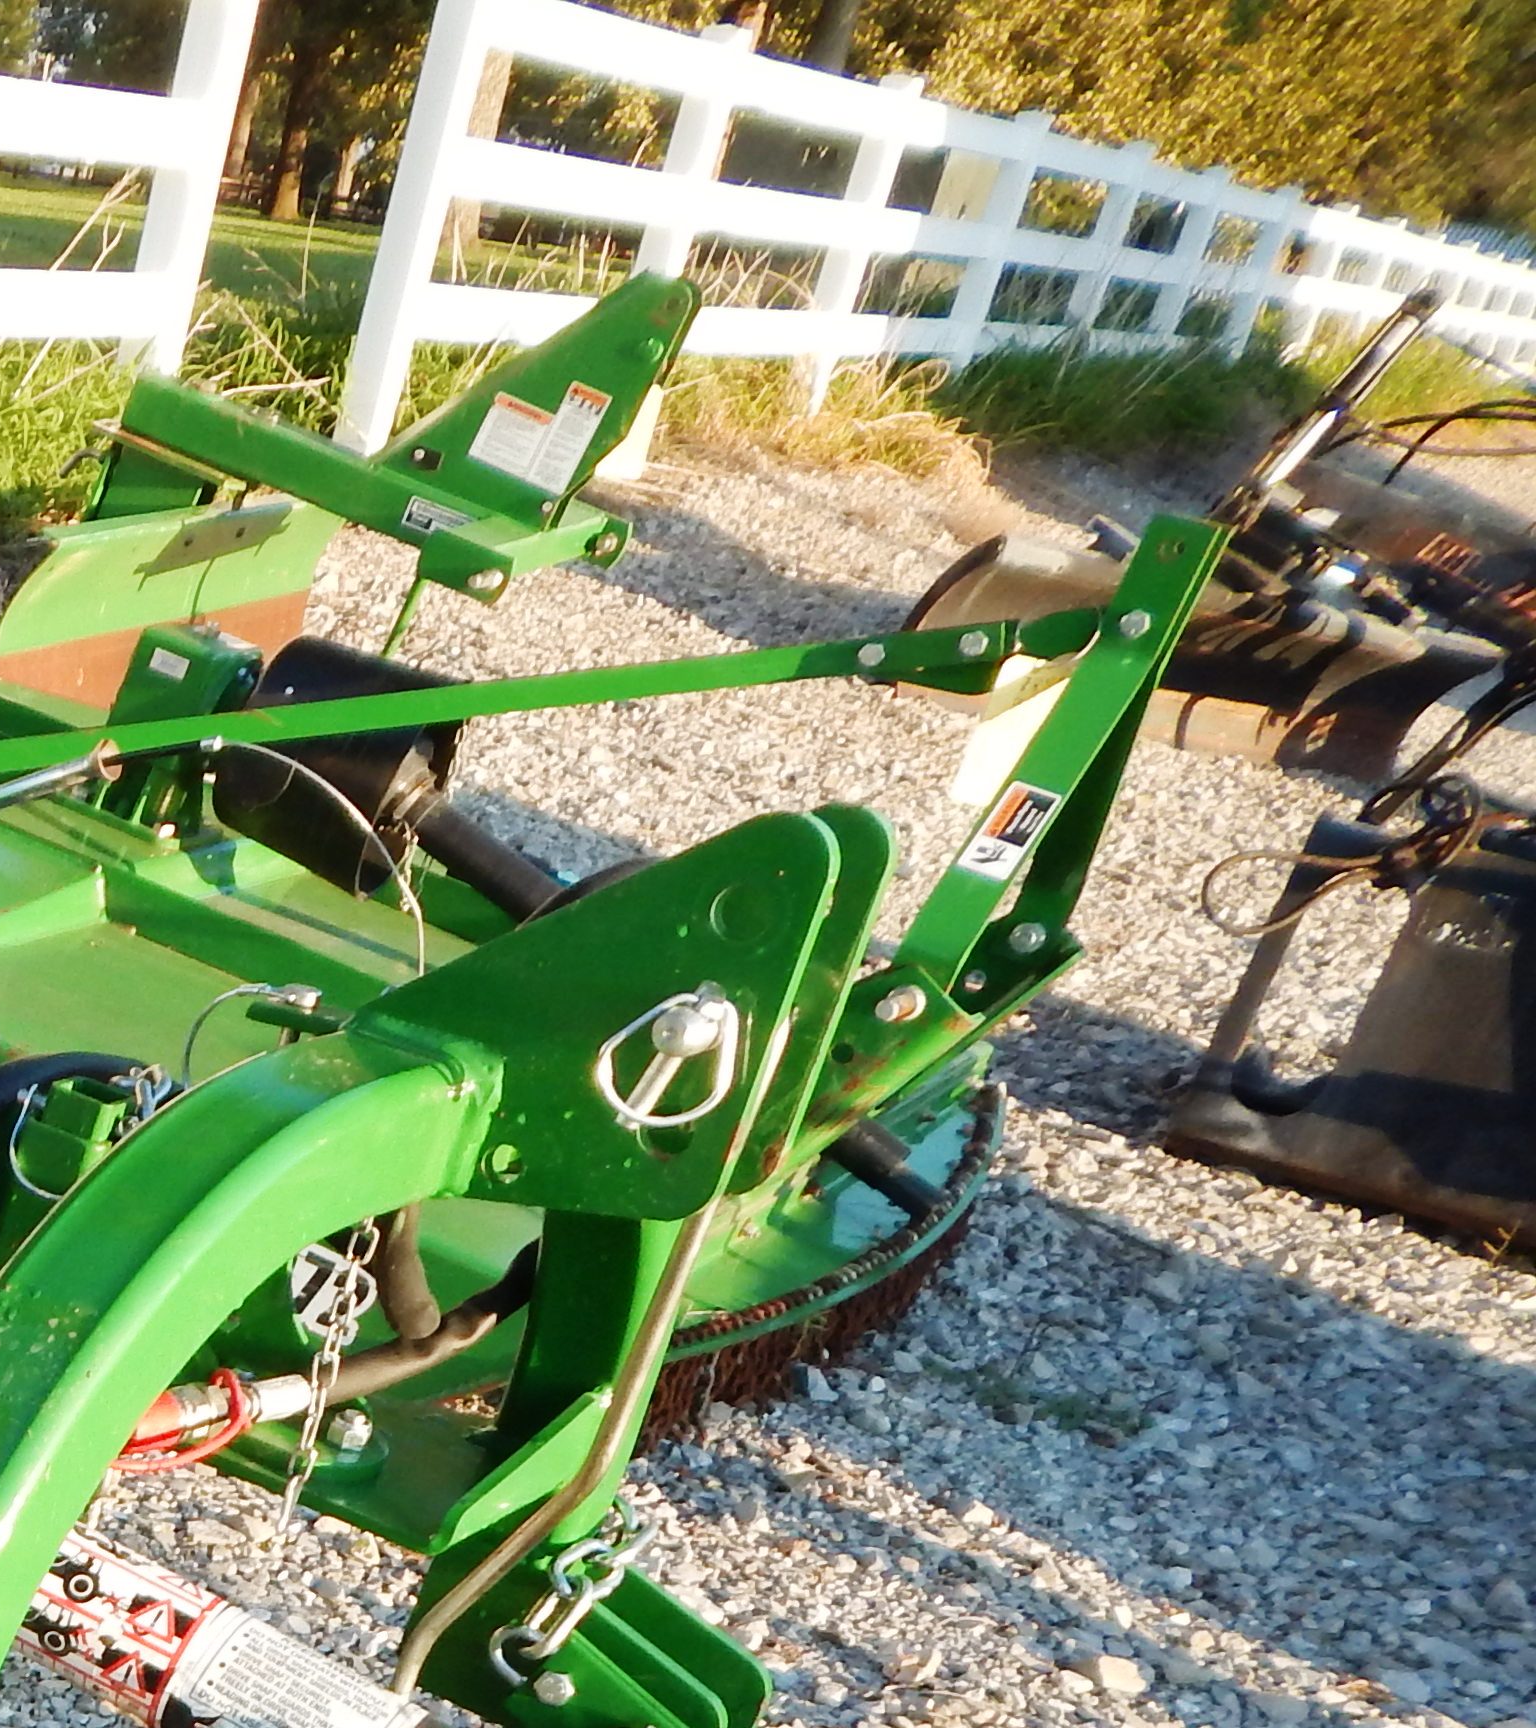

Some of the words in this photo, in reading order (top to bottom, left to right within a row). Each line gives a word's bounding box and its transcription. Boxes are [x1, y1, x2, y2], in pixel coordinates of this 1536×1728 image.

[219, 1672, 250, 1694] FREELY
[249, 1690, 263, 1702] ON
[262, 1697, 287, 1716] DRIVE
[225, 1664, 250, 1683] DRIVE
[250, 1679, 277, 1699] SHAFT
[277, 1695, 312, 1719] GUARDS
[232, 1655, 274, 1683] ATTACHED
[273, 1678, 286, 1690] AT
[285, 1685, 309, 1703] BOTH
[308, 1698, 332, 1717] ENDS
[238, 1648, 262, 1666] DRIVE
[264, 1663, 290, 1681] SHAFT
[290, 1678, 330, 1705] SECURELY
[266, 1636, 288, 1652] NOT
[290, 1649, 337, 1679] OPERATE
[339, 1677, 386, 1708] WITHOUT
[196, 1688, 215, 1704] DO
[214, 1699, 239, 1718] NOT
[351, 1702, 379, 1721] PLACE
